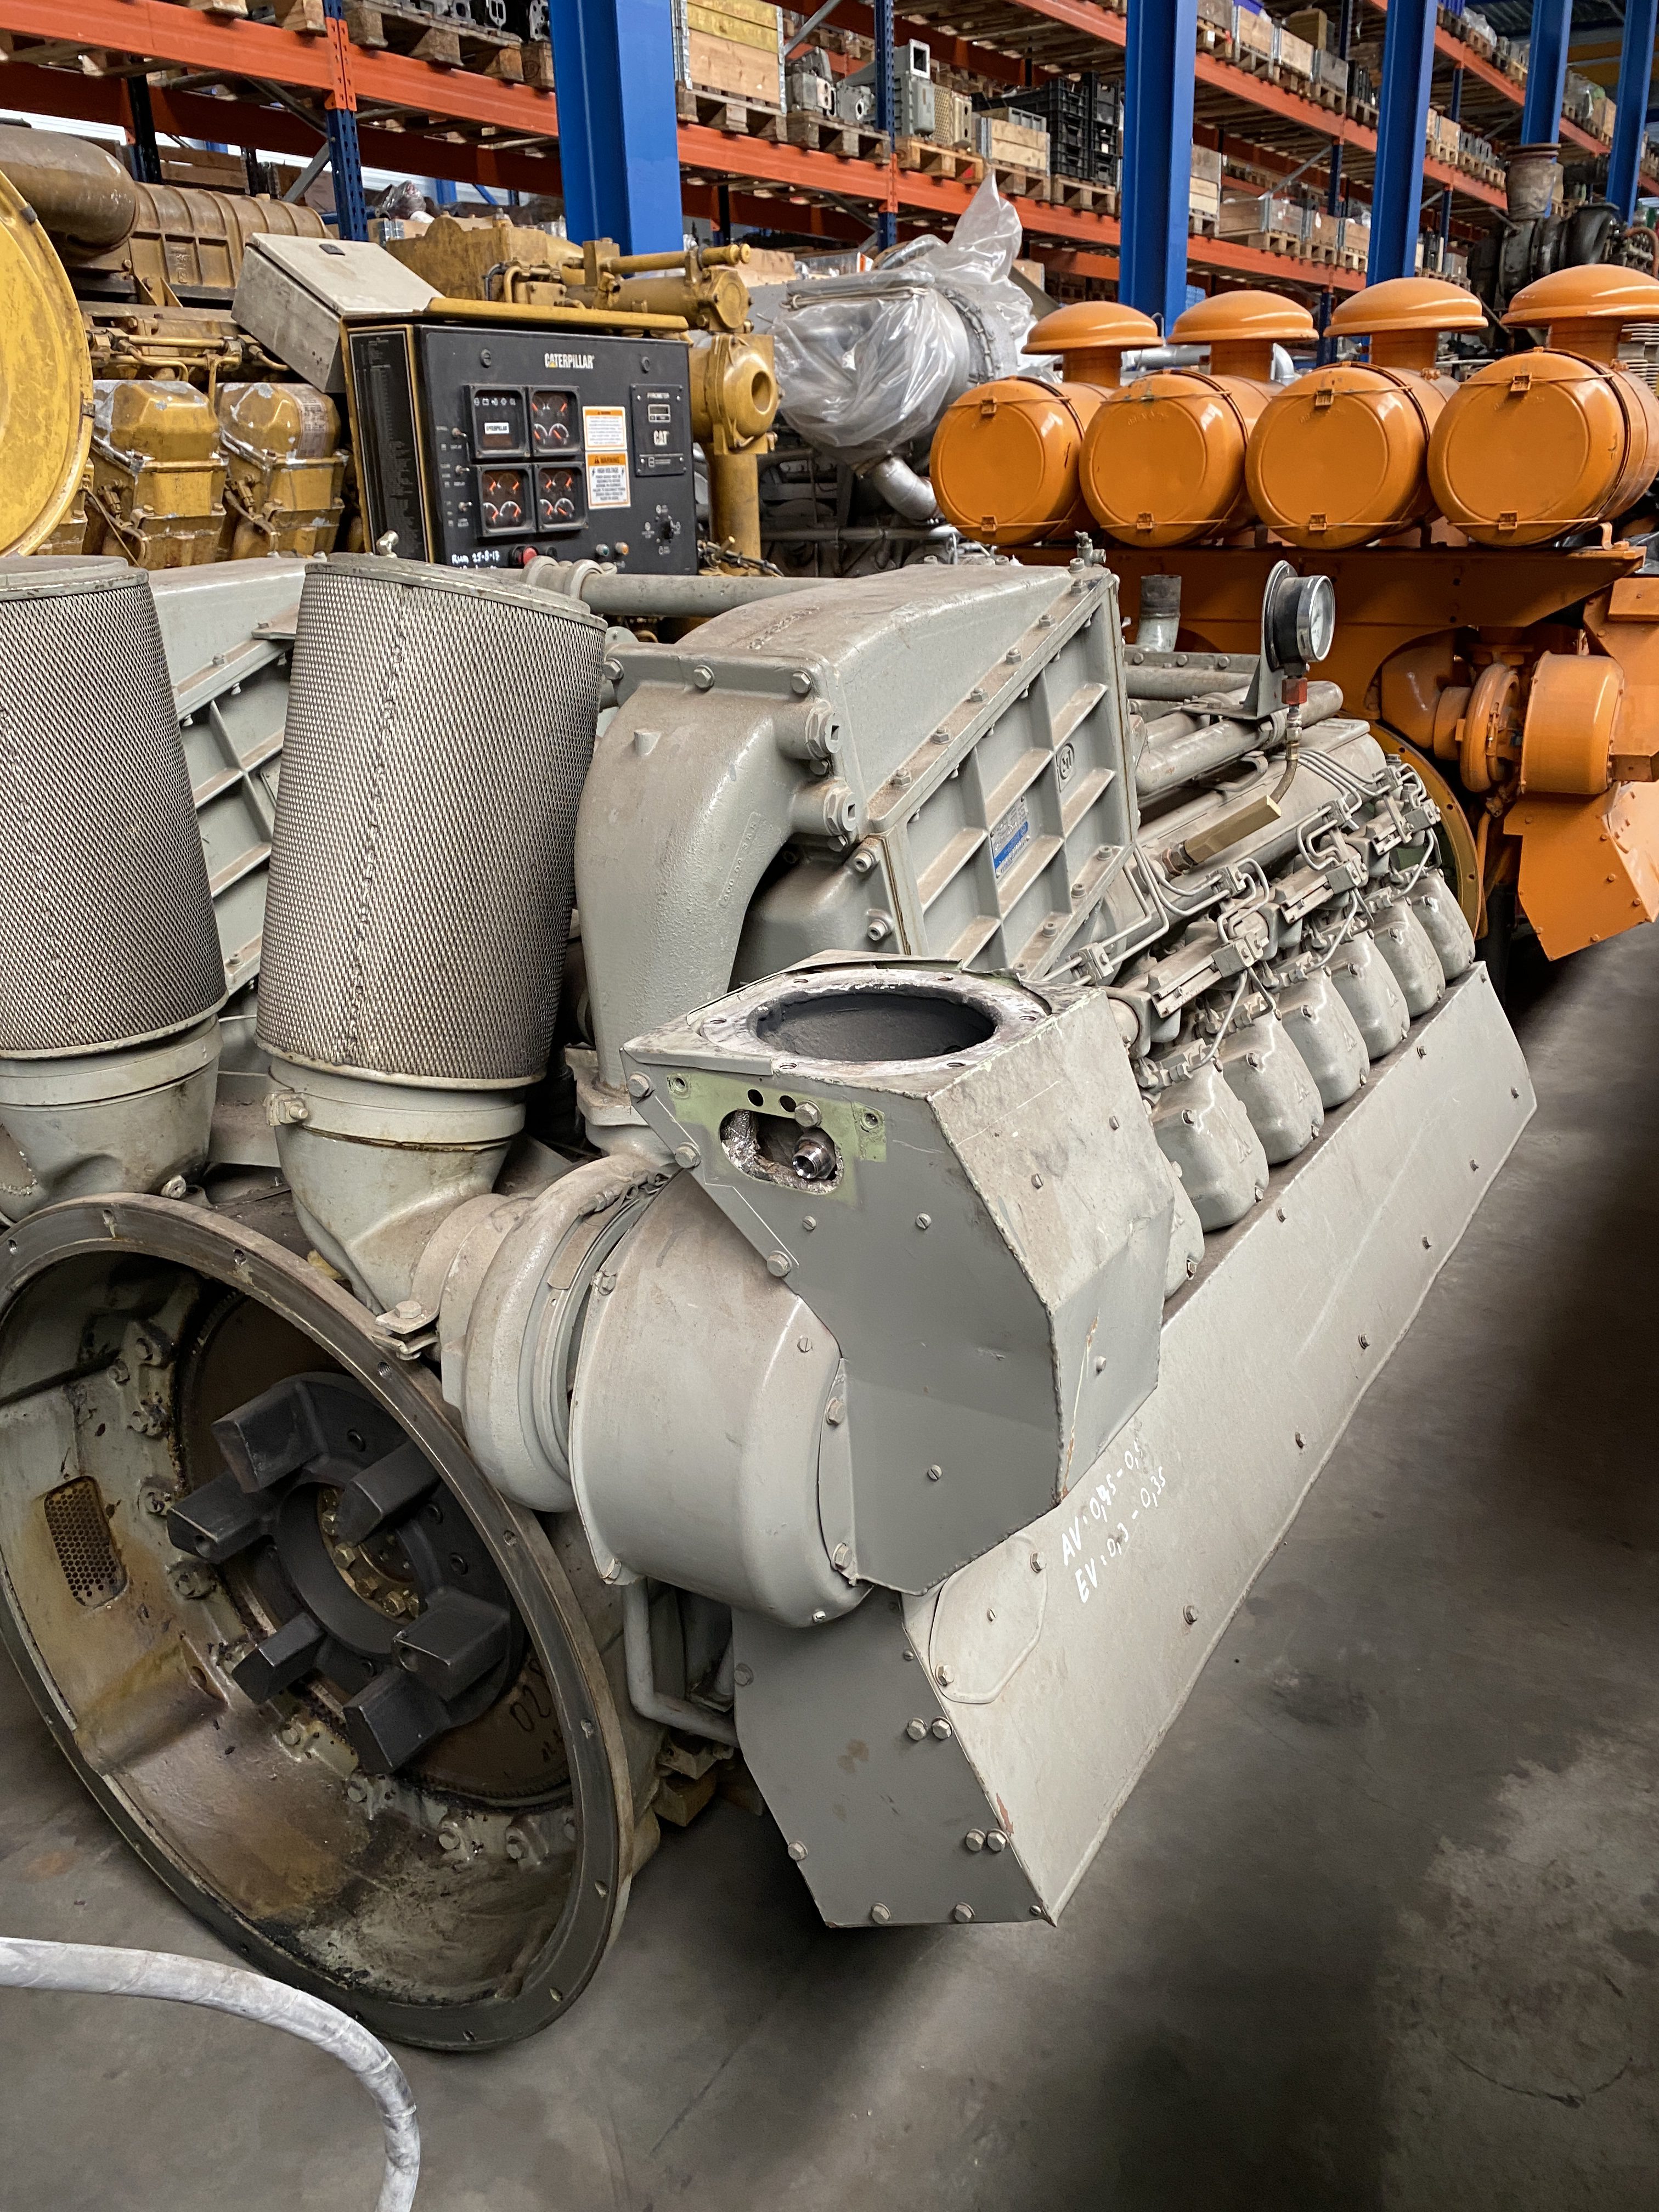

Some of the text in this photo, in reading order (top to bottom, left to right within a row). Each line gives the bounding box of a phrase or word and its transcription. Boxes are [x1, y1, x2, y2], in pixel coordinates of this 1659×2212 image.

[544, 353, 594, 369] CATERPILLAR
[653, 430, 667, 445] CAT
[452, 554, 469, 565] Run
